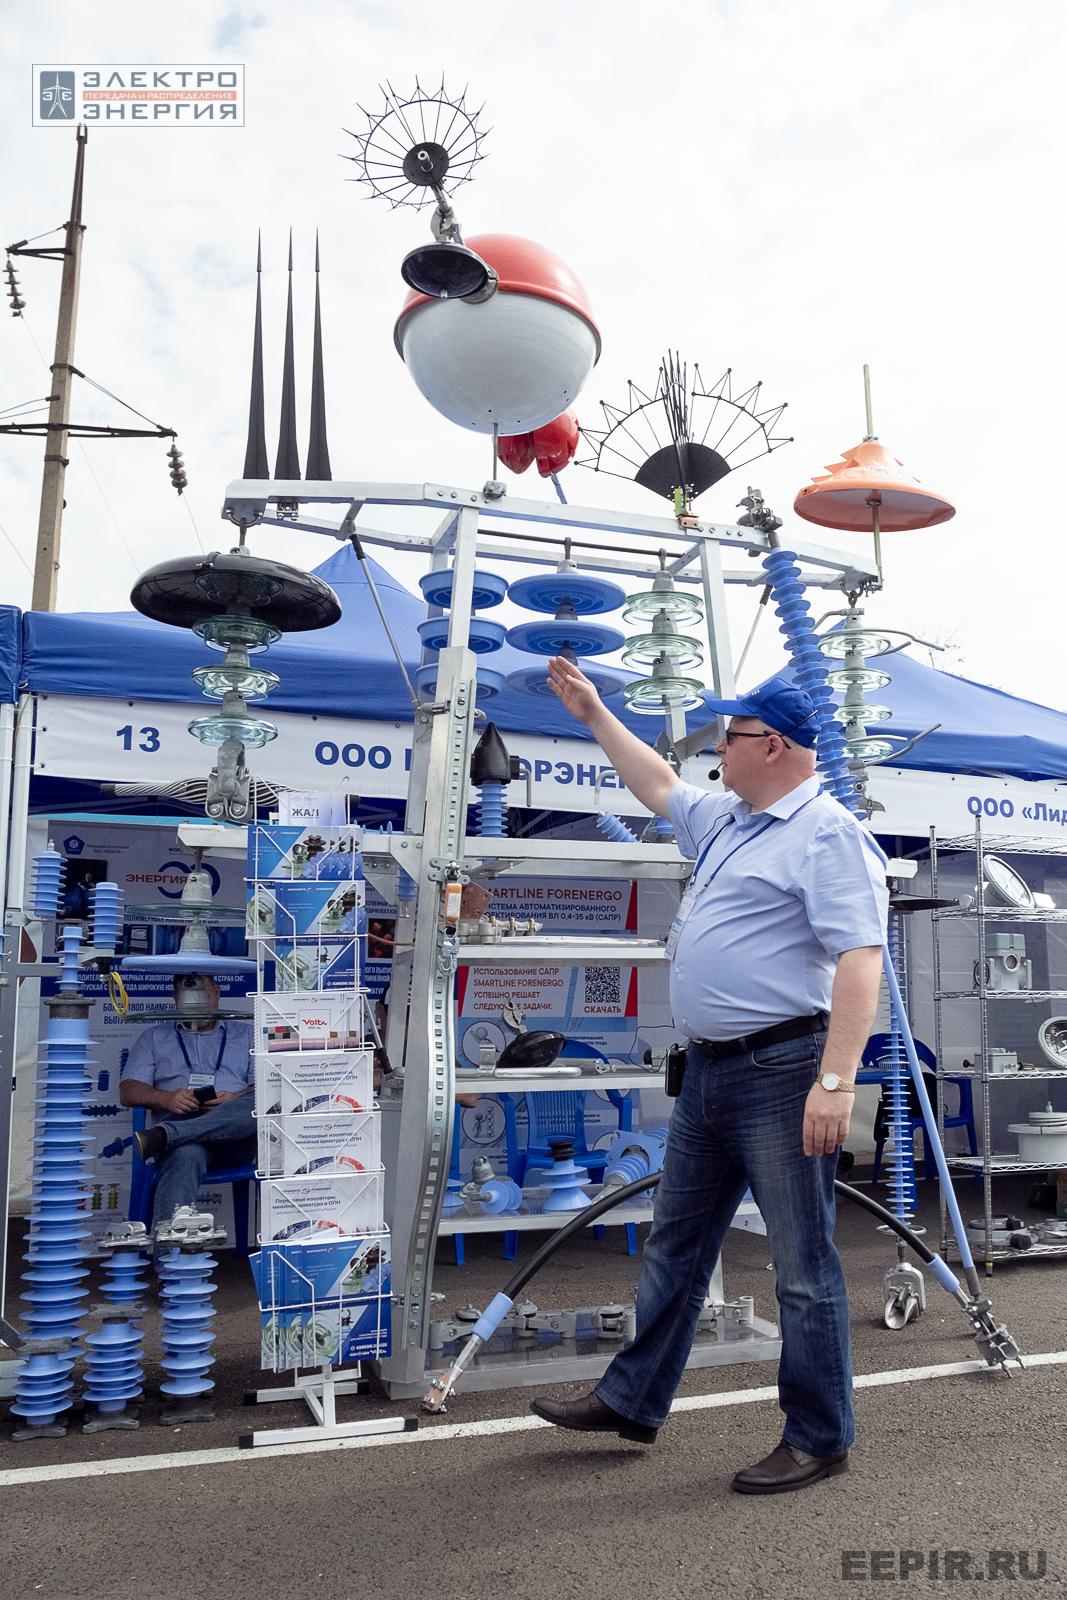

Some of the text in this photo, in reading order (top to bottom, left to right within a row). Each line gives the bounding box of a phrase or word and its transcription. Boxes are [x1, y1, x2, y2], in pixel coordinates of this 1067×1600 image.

[116, 725, 161, 753] 13
[315, 741, 392, 770] ООО
[519, 757, 626, 790] ОРЭНЕ
[967, 796, 1014, 818] ООО
[126, 873, 187, 885] ЭНЕРГИЯ
[547, 888, 623, 901] FORENERGO
[519, 902, 617, 912] АВТОМАТИЗИРОВАННОГО
[549, 912, 559, 920] ВЛ
[596, 913, 622, 922] (САПР)
[473, 967, 560, 976] ИСПОЛЬЗОВАНИЕ САПР
[121, 974, 144, 982] МЕРНЫХ
[144, 974, 175, 983] ИЗОЛЯТОРО
[473, 978, 564, 988] SMARTLINE FORENERGO
[473, 991, 541, 999] УСПЕШНО РЕШАЕТ
[128, 1003, 144, 1012] 1800
[145, 1003, 177, 1013] НАИМЕНО
[522, 1002, 553, 1011] ЗАДАЧИ:
[584, 1005, 621, 1014] СКАЧАТЬ
